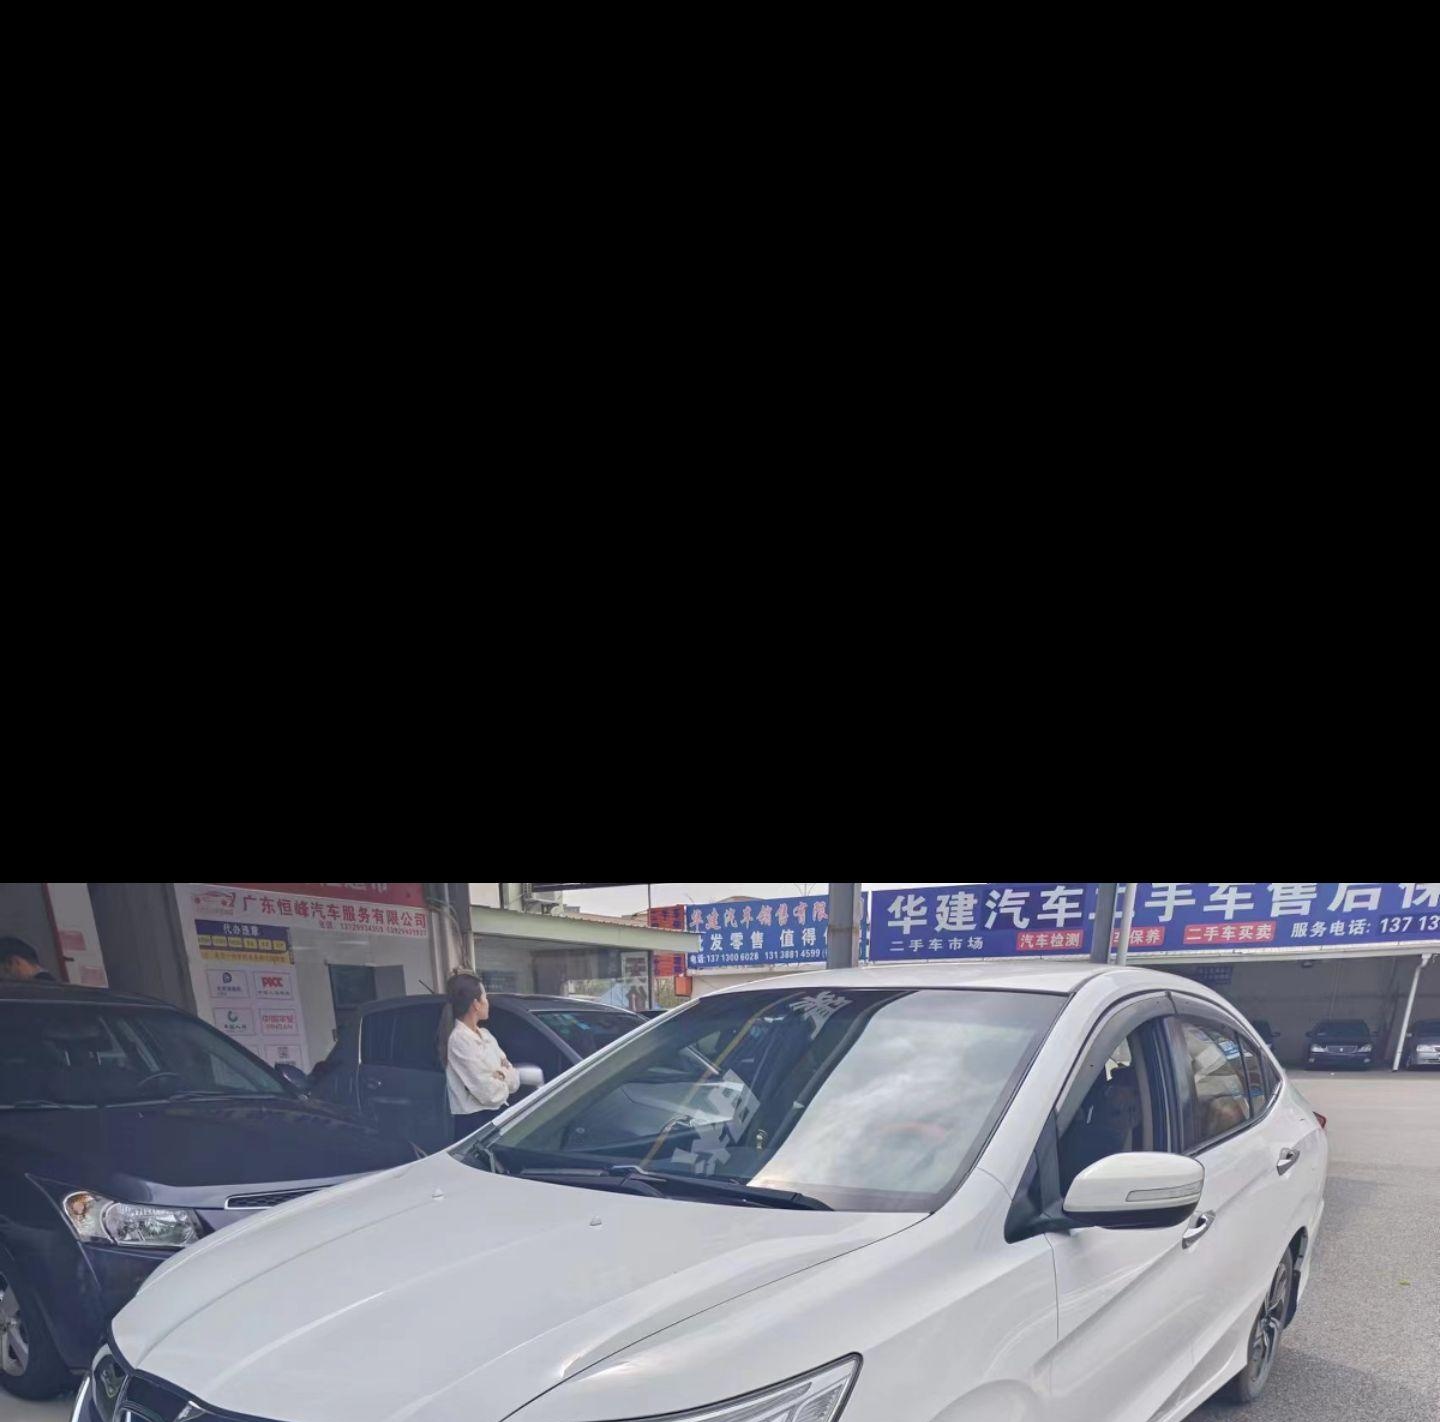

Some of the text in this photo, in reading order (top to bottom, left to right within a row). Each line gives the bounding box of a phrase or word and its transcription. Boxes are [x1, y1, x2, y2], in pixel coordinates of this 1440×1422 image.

[779, 926, 829, 948] 值得
[1020, 932, 1081, 949] 汽车检测
[1186, 924, 1272, 942] 二手车买卖
[889, 936, 984, 952] 二手车市场
